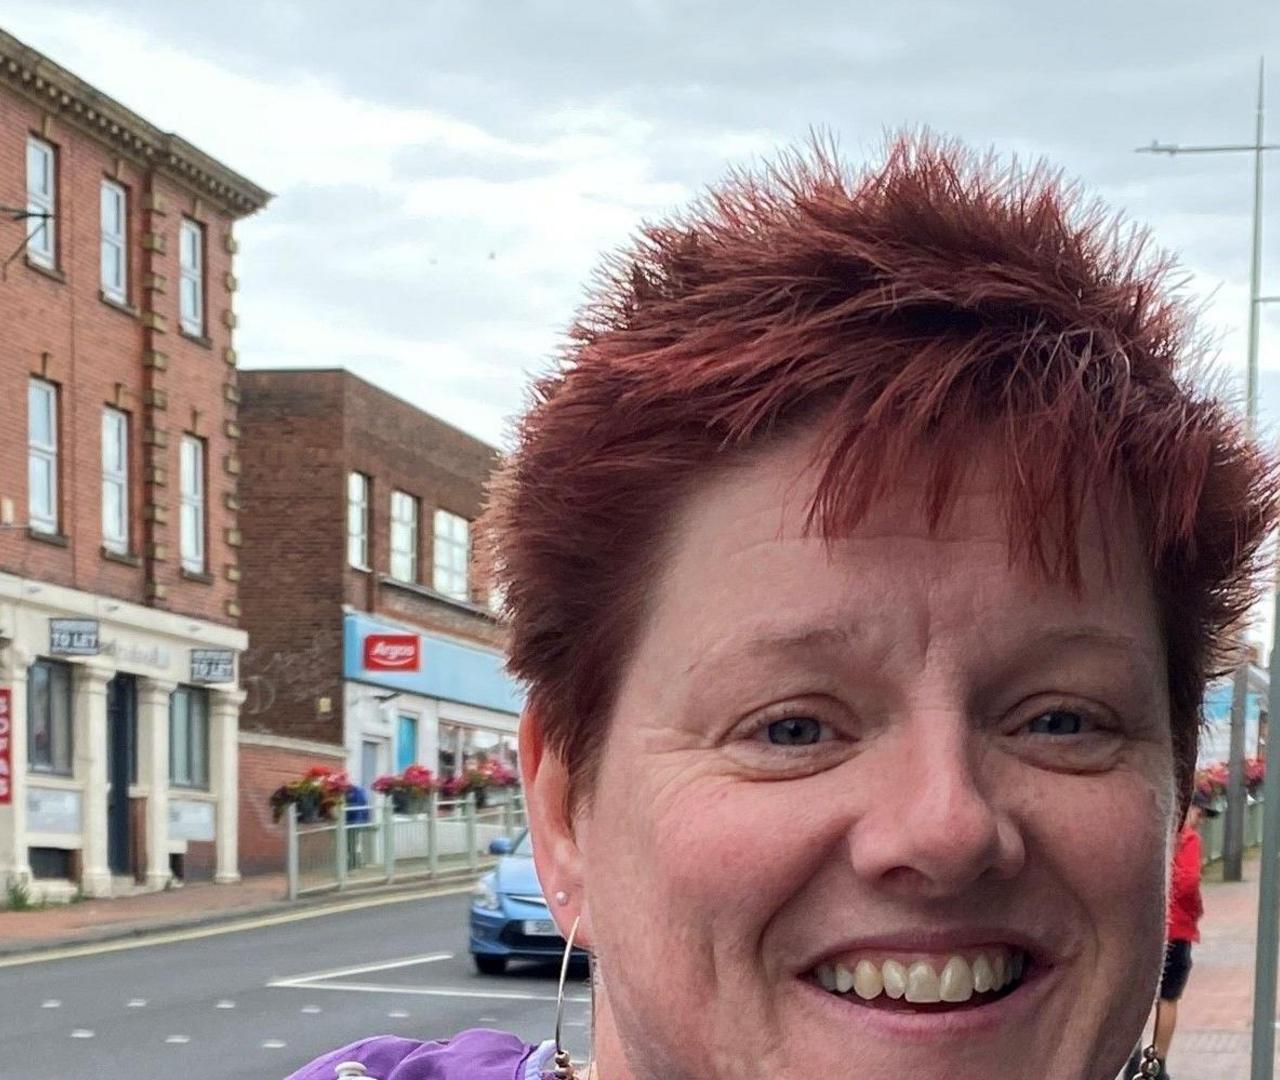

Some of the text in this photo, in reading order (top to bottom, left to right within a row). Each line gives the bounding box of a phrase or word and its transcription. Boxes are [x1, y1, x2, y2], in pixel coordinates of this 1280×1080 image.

[52, 632, 98, 649] TO LET
[368, 641, 416, 660] Argos
